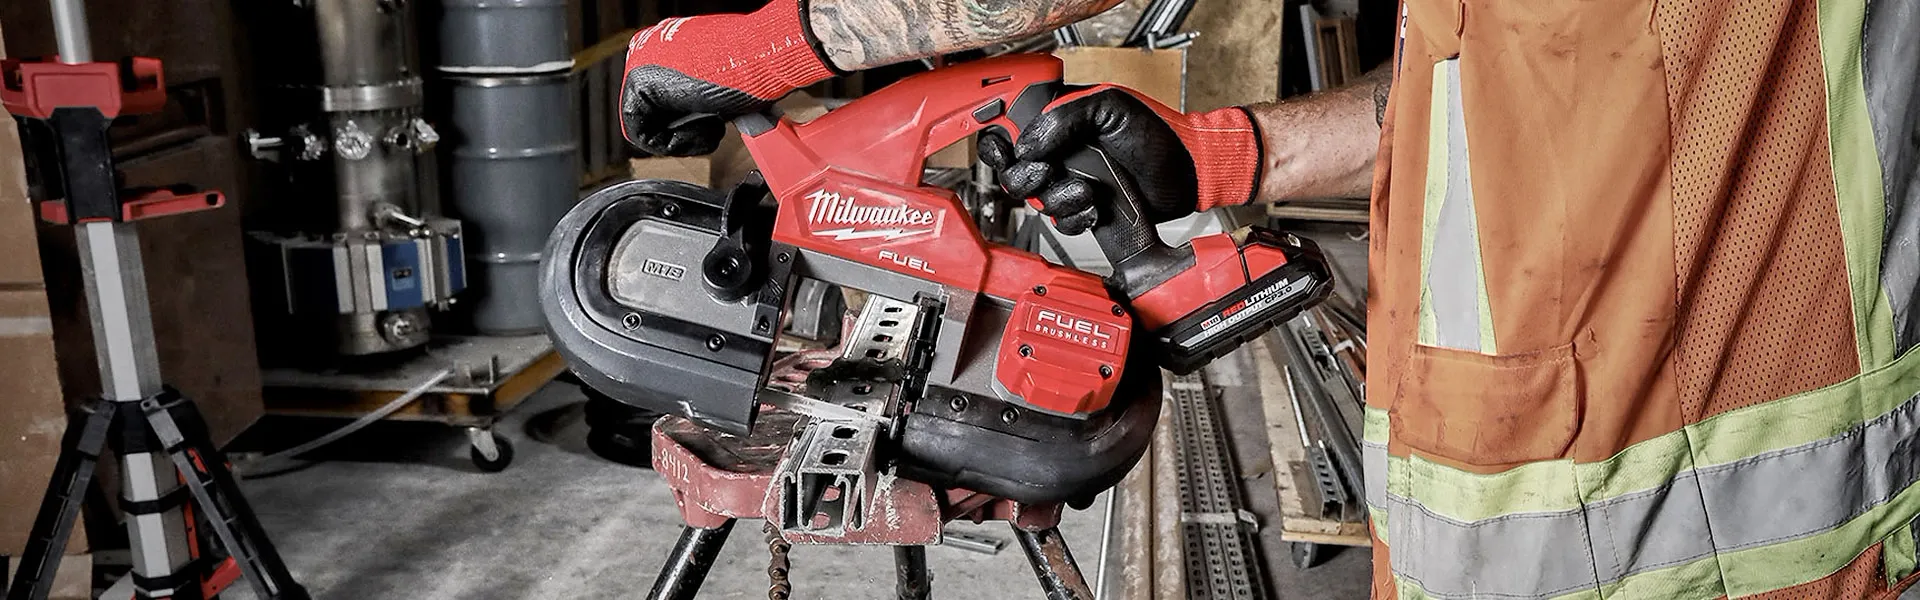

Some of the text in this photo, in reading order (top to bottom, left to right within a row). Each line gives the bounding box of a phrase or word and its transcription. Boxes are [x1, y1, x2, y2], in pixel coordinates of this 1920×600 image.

[804, 189, 935, 226] Milwaukee
[646, 261, 684, 278] M18
[878, 250, 936, 274] FUEL
[1221, 278, 1289, 318] REDLITHIUM
[1035, 324, 1107, 349] BRUSHLESS
[1038, 310, 1111, 339] FUEL
